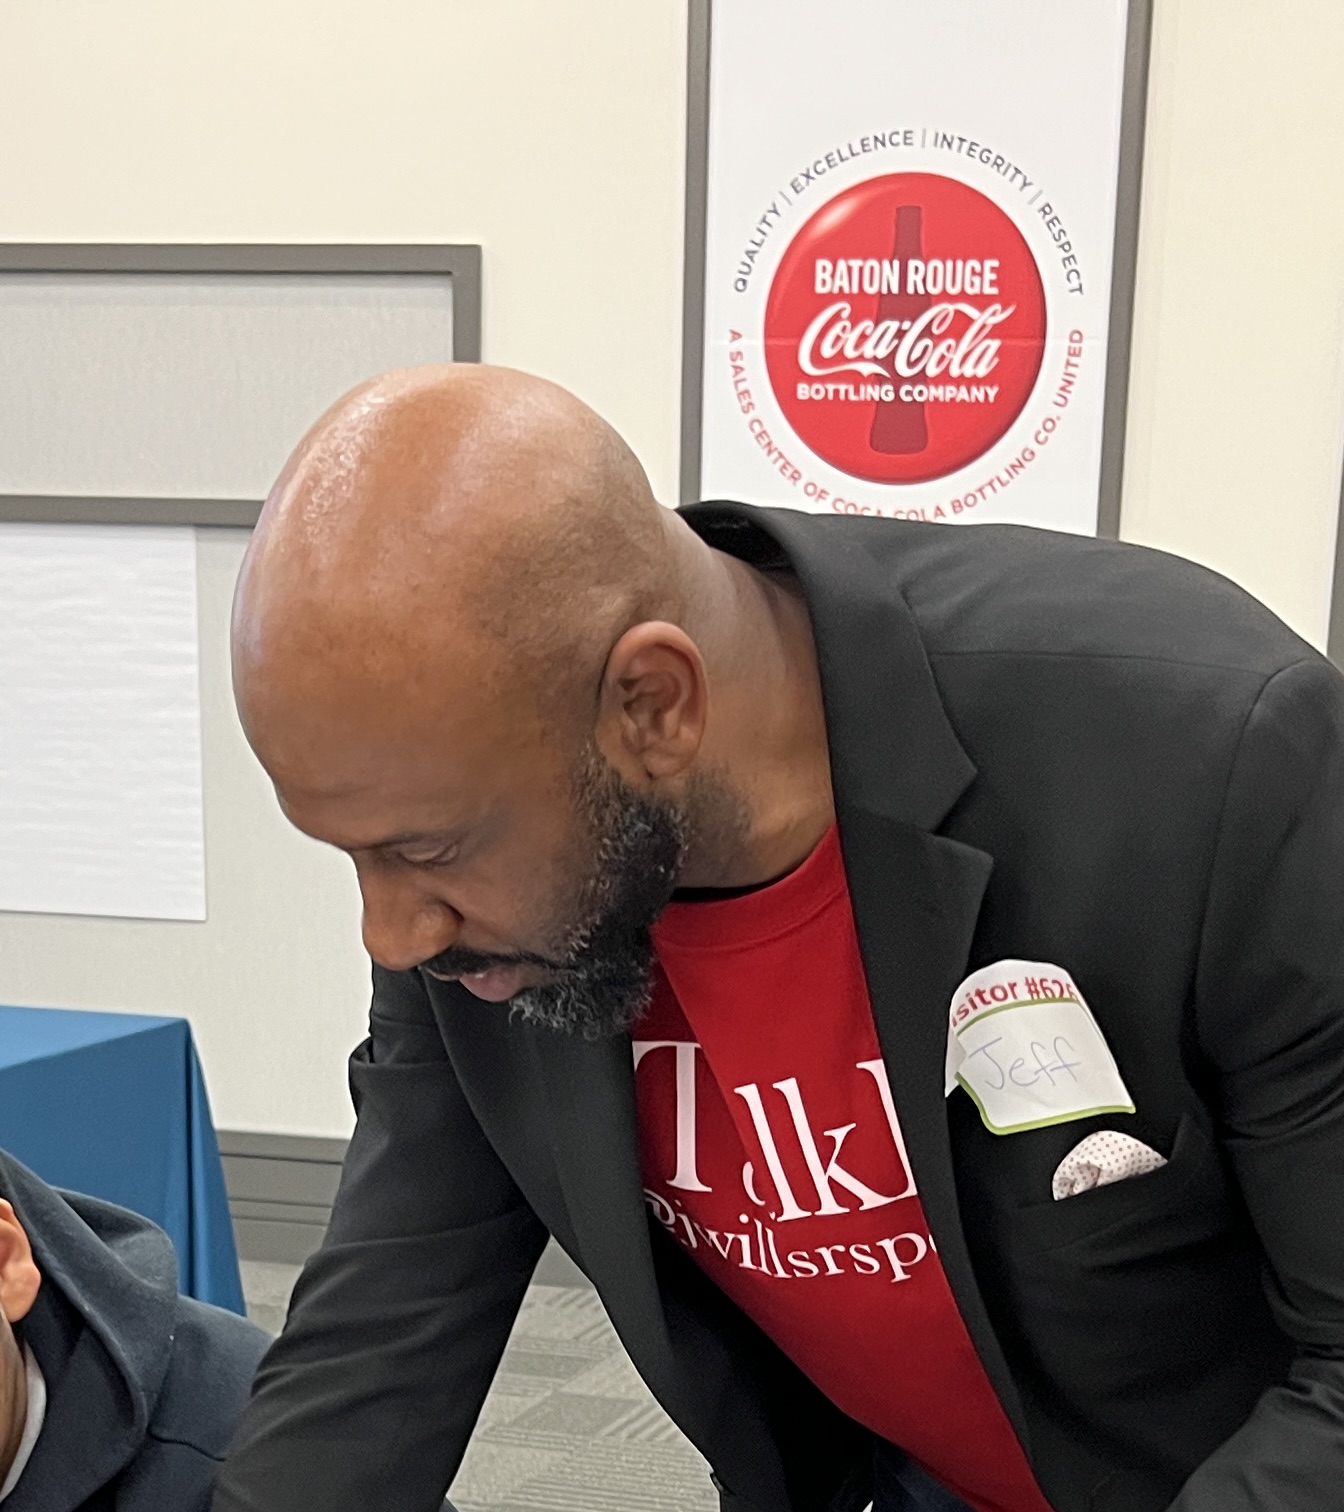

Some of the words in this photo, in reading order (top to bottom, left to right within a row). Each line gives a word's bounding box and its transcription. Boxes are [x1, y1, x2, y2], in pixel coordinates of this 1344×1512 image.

[733, 205, 783, 293] QUALITY
[791, 129, 915, 195] EXCELLENCE
[933, 131, 1033, 193] INTEGRITY
[1038, 202, 1085, 296] RESPECT
[814, 258, 899, 295] BATON
[906, 259, 1000, 296] ROUGE
[728, 328, 743, 345] A
[797, 301, 1017, 379] Coca-Cola
[729, 350, 755, 416] SALES
[796, 382, 895, 402] BOTTLING
[899, 384, 999, 404] COMPANY
[1054, 328, 1084, 409] UNITED
[748, 417, 802, 487] CENTER
[1034, 415, 1061, 446] CO.
[803, 481, 831, 504] OF
[952, 449, 1036, 515] BOTTLING
[968, 1036, 1081, 1090] Jeff
